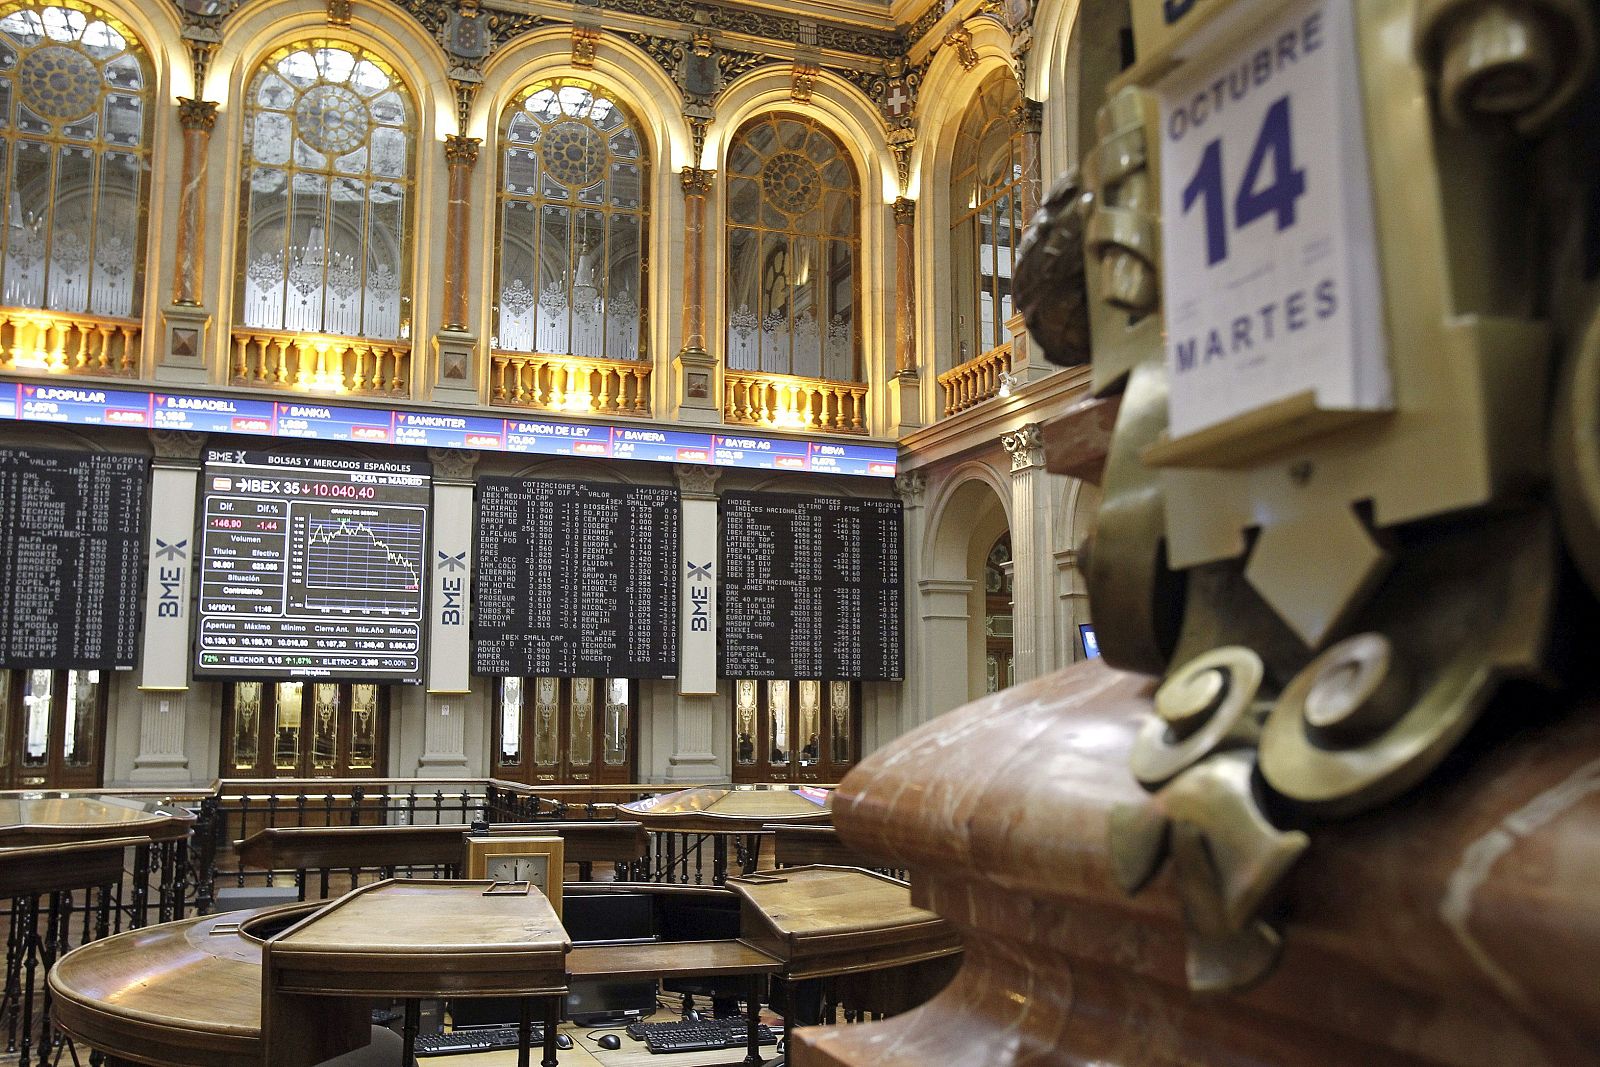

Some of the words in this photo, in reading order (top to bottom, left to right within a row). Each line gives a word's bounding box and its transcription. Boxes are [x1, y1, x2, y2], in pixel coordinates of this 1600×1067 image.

[1168, 11, 1325, 142] OCTUBRE
[1182, 91, 1307, 268] 14
[1176, 279, 1338, 373] MARTES
[36, 388, 105, 404] B.POPULAR
[168, 397, 236, 412] B.SABADELL
[290, 406, 330, 419] BANKIA
[408, 416, 465, 428] BANKINTER
[519, 423, 553, 434] BARON
[555, 426, 569, 435] DE
[570, 427, 590, 436] LEY
[625, 431, 665, 442] BAVIERA
[725, 439, 756, 448] BAYER
[757, 441, 771, 450] AG
[91, 456, 143, 464] 14/10/2014
[208, 451, 232, 462] BME
[268, 456, 301, 465] BOLSAS
[313, 459, 360, 469] MERCADOS
[364, 462, 411, 472] ESPAÑOLES
[351, 474, 377, 483] BOLSA
[388, 476, 422, 486] MADRID
[247, 479, 280, 494] IBEX
[283, 482, 300, 494] 35
[313, 484, 374, 499] 10.040,40
[636, 488, 677, 496] 14/10/2014
[220, 502, 234, 511] Dif.
[257, 505, 278, 513] Dif.%
[482, 498, 518, 506] ACERINOX
[231, 535, 261, 543] Volumen
[158, 567, 180, 618] BME
[223, 587, 263, 595] Contratando
[442, 577, 460, 625] BME
[692, 586, 707, 632] BME
[206, 622, 235, 630] Apertura
[244, 622, 271, 630] Máximo
[230, 656, 264, 664] ELECNOR
